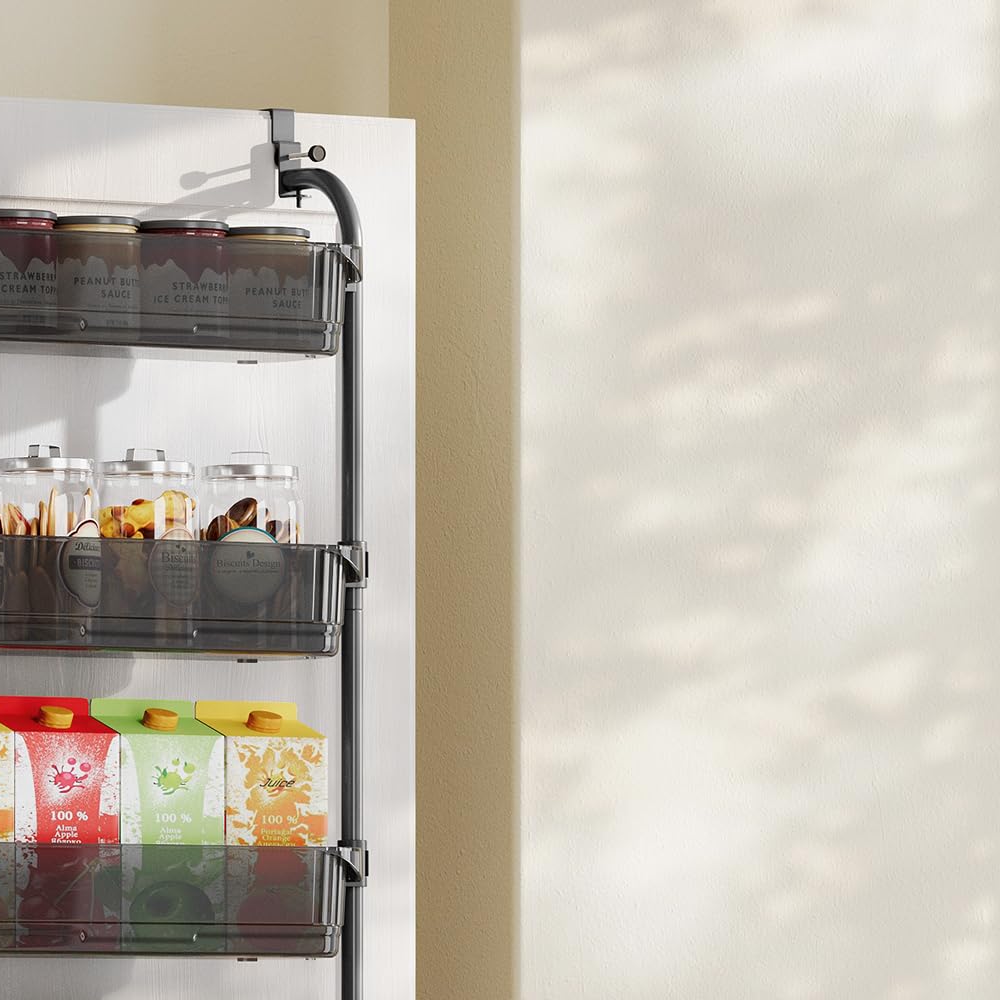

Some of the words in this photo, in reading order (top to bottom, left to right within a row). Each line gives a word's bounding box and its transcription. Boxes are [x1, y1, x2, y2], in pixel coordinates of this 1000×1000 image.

[73, 276, 116, 286] PEANUT
[1, 283, 37, 294] CREAM
[245, 287, 287, 296] PEANUT
[101, 289, 131, 299] SAUCE
[153, 294, 169, 304] ICE
[174, 294, 209, 304] CREAM
[272, 299, 302, 309] SAUCE
[216, 558, 250, 569] Biscuits
[252, 558, 281, 570] Design
[259, 777, 296, 788] Juice
[50, 810, 73, 821] 100
[76, 810, 89, 821] %
[155, 812, 177, 823] 100
[180, 812, 193, 824] %
[262, 815, 283, 825] 100
[286, 815, 298, 824] %
[55, 824, 78, 832] Alma
[54, 831, 79, 839] Apple
